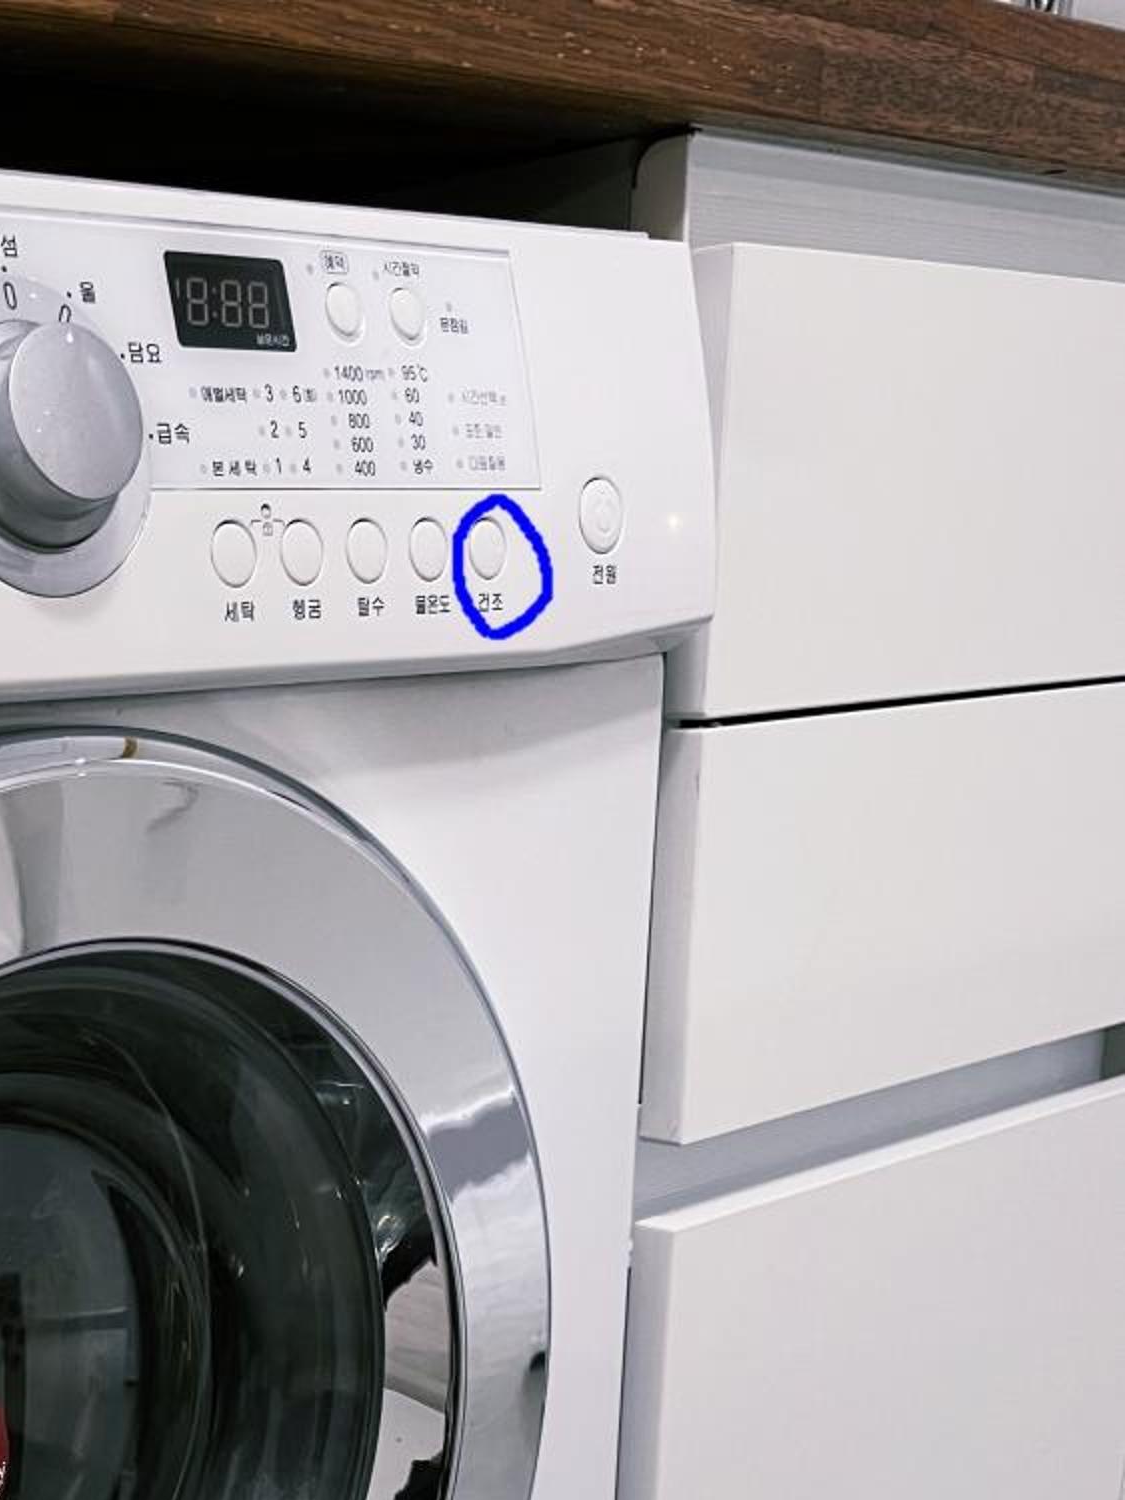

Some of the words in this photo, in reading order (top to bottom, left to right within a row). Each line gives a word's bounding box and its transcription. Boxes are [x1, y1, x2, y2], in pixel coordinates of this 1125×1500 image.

[264, 383, 274, 403] 3
[292, 384, 302, 404] 6
[338, 388, 368, 406] 1000
[348, 412, 371, 429] 800
[408, 411, 424, 427] 40
[156, 422, 190, 445] 급속
[269, 419, 280, 439] 2
[298, 421, 308, 439] 5
[350, 436, 374, 453] 600
[410, 433, 427, 451] 30
[302, 457, 312, 473] 4
[354, 459, 376, 477] 400
[224, 601, 255, 623] 세탁
